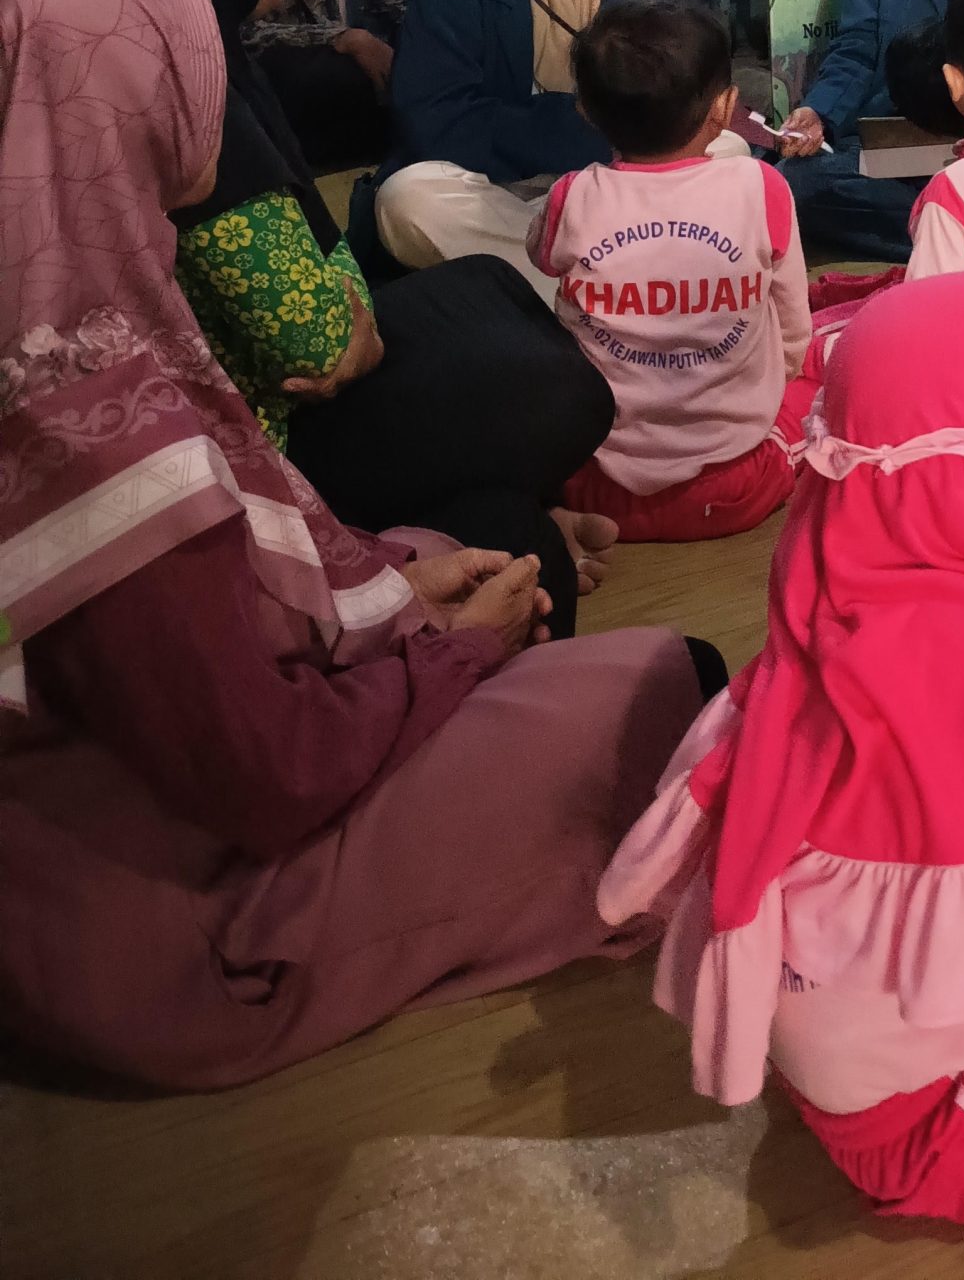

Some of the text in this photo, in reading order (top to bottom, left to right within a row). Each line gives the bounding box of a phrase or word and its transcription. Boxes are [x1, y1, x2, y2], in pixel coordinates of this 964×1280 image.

[802, 23, 821, 38] No
[580, 221, 743, 271] POS PAUD TERPADU
[563, 271, 762, 317] KHADIJAH
[595, 329, 611, 347] 02
[607, 339, 667, 370] KEJAWAN
[669, 349, 707, 370] PUTIH
[706, 317, 750, 361] TAMBAK
